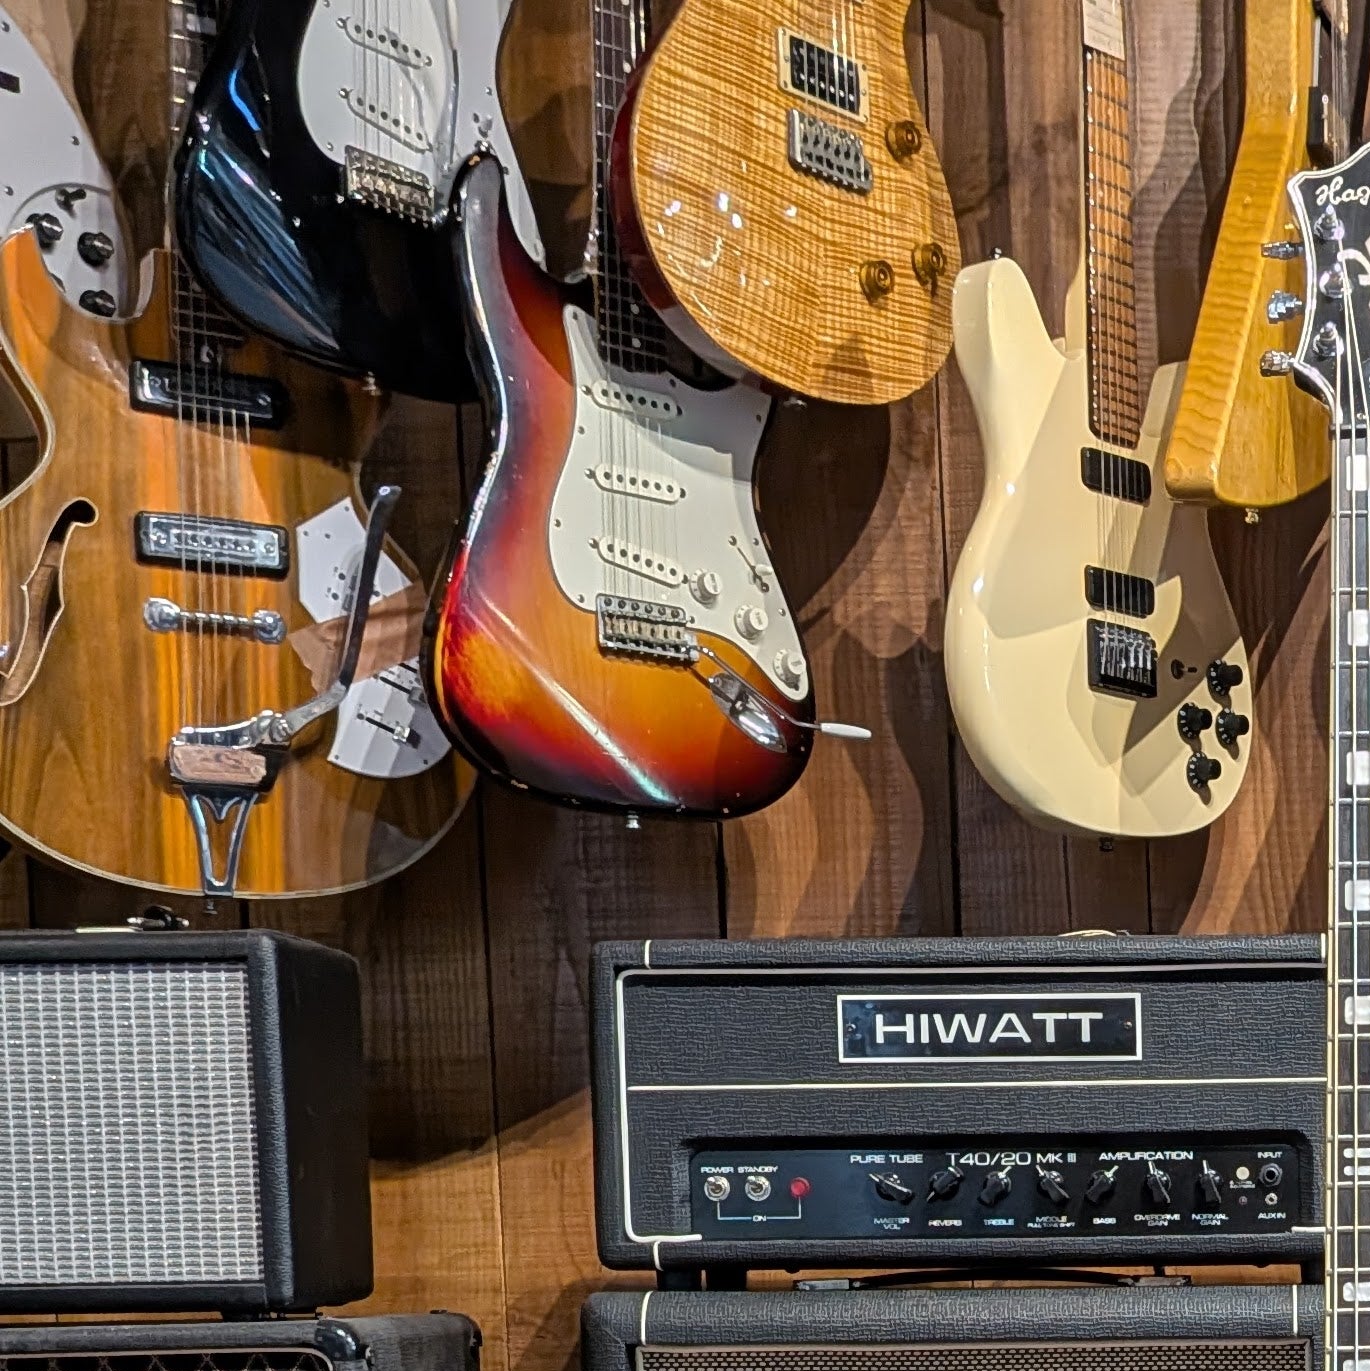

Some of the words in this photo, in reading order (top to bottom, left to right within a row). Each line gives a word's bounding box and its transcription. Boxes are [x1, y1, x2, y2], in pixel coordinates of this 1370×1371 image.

[875, 1012, 1103, 1044] HIWATT
[850, 1154, 886, 1164] PURE
[889, 1154, 924, 1163] TUBE
[945, 1152, 1032, 1166] T40/20
[1036, 1153, 1063, 1163] MK
[1099, 1150, 1194, 1161] AMPLIFICATION
[1257, 1151, 1283, 1159] INPUT
[700, 1166, 734, 1174] POWER
[873, 1217, 910, 1225] MASTER
[1092, 1217, 1117, 1225] BASS
[1133, 1213, 1181, 1221] OVERDRIVE
[1191, 1213, 1229, 1221] NORMAL
[928, 1219, 963, 1227] REVERB
[983, 1218, 1015, 1226] TREBLE
